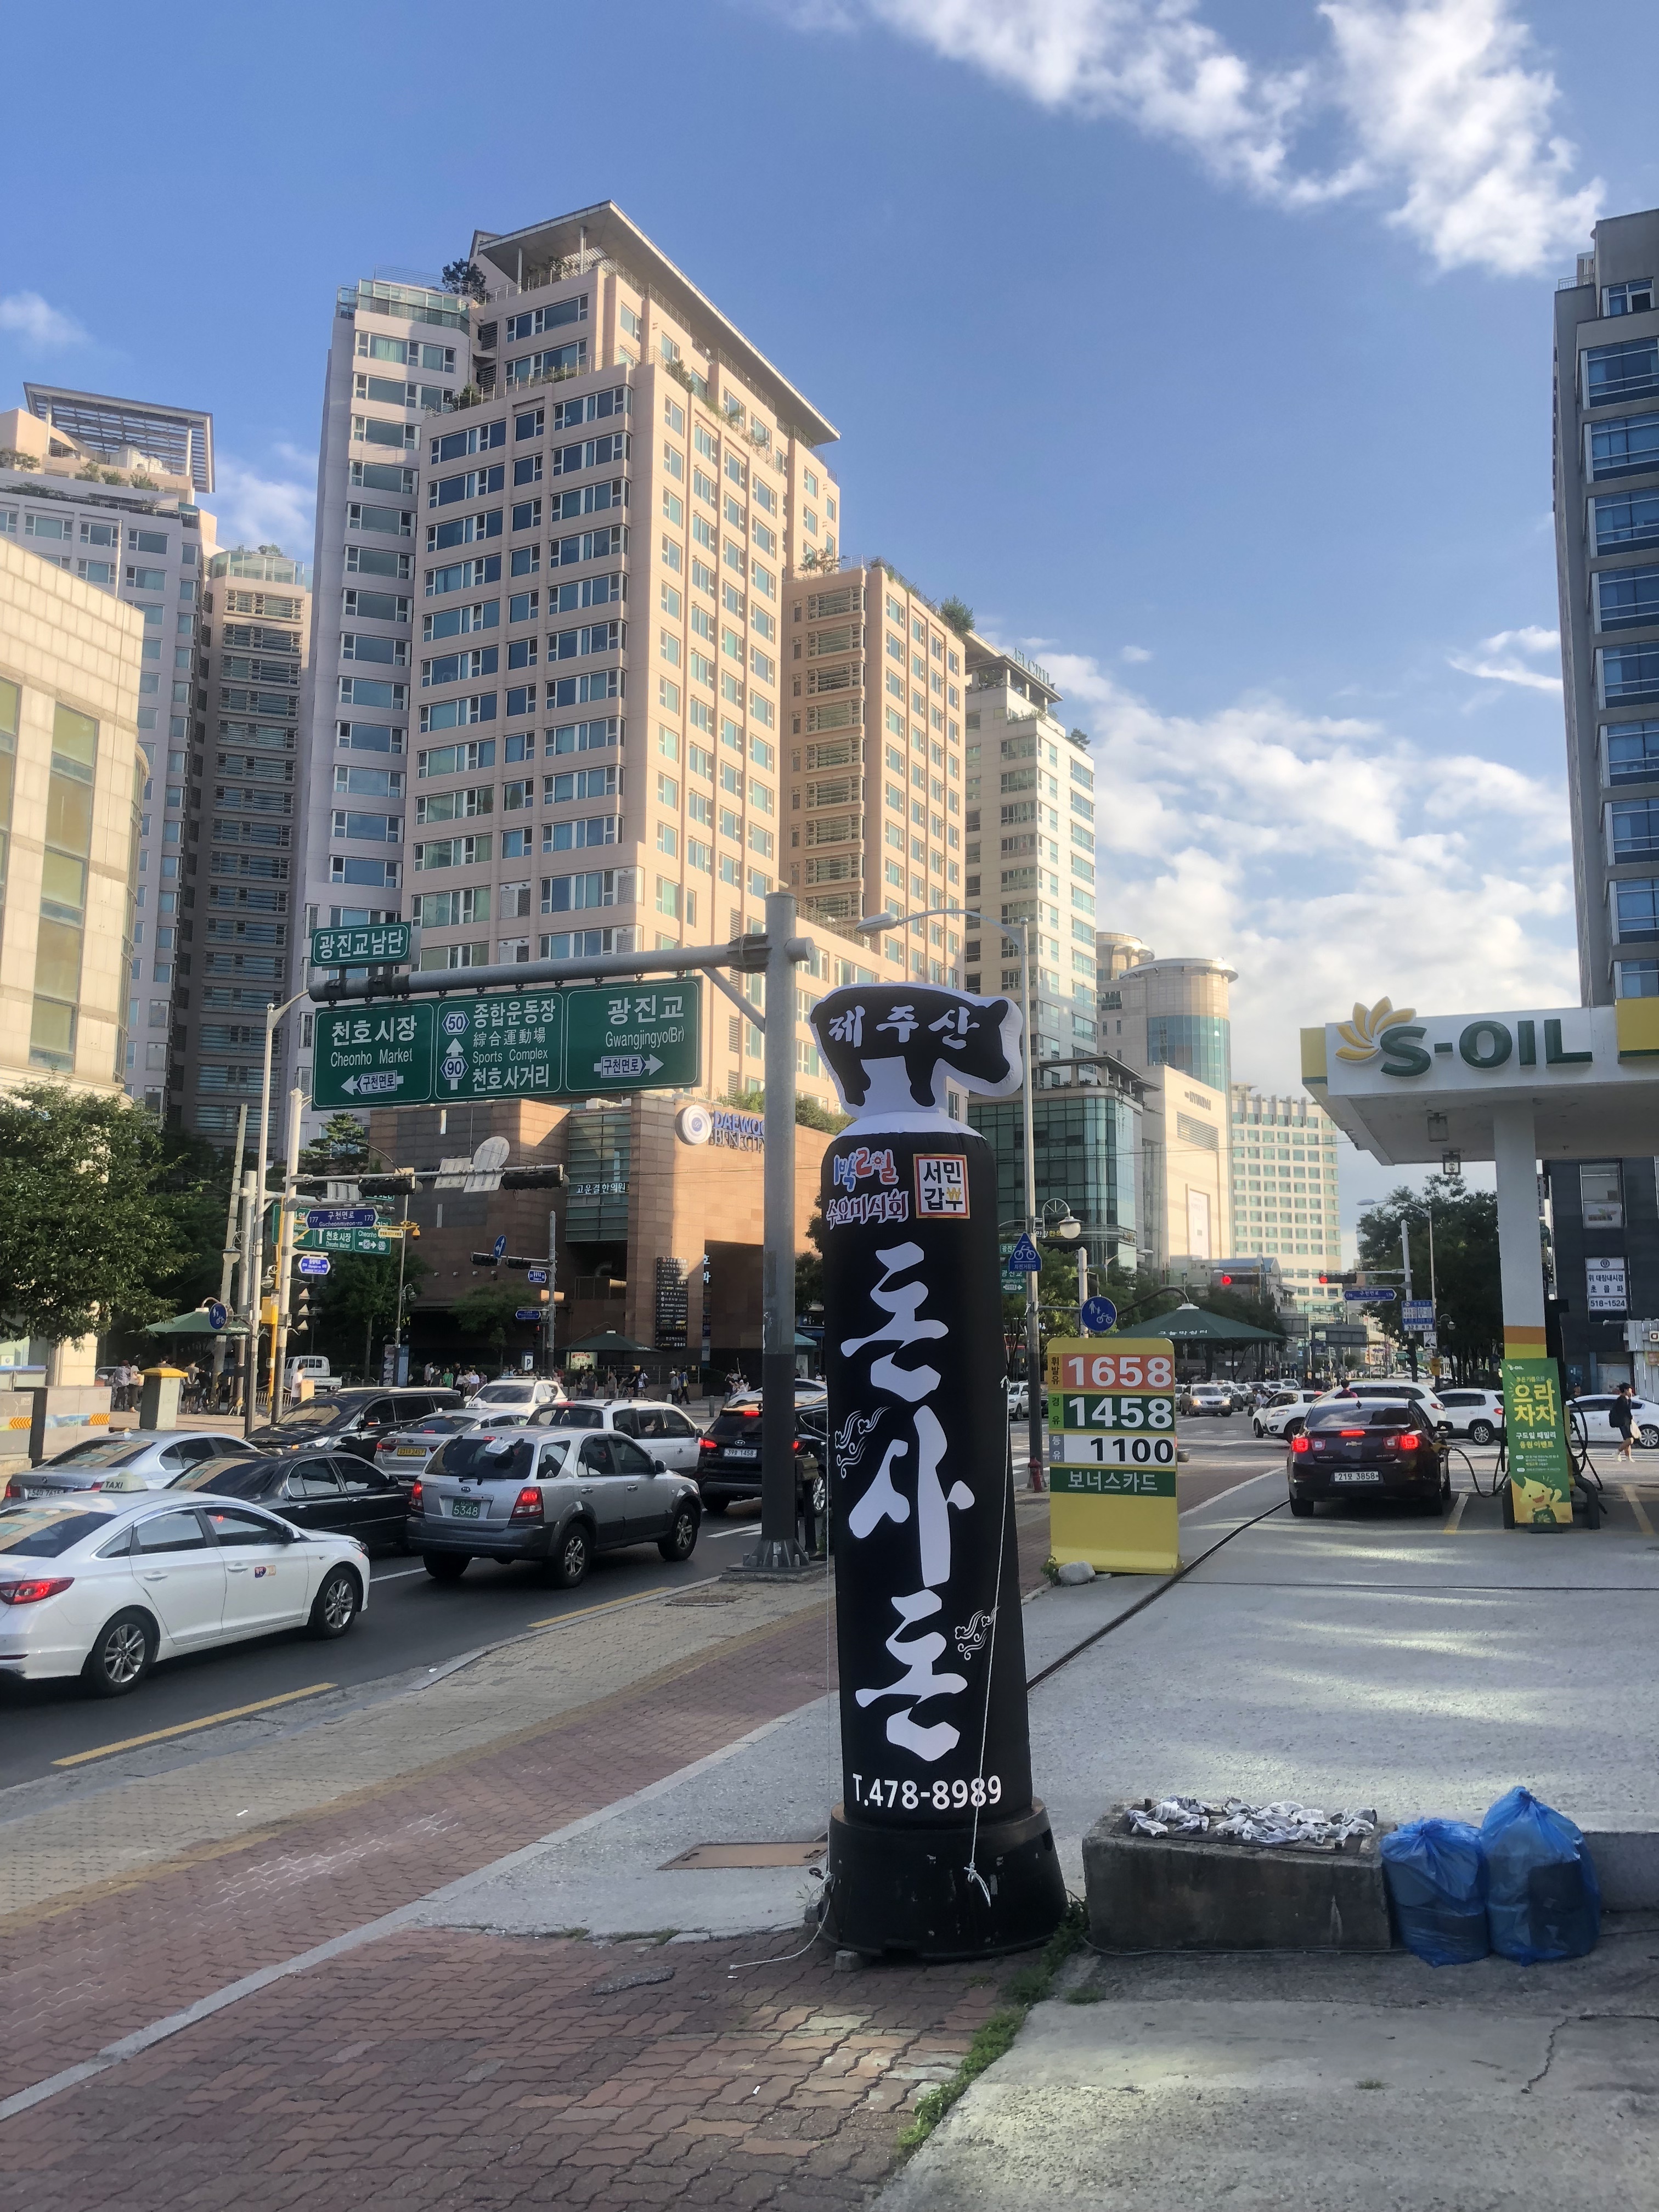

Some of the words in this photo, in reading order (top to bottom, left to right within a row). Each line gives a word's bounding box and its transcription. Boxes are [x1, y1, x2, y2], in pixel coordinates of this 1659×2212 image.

[319, 929, 403, 959] 광진교남단
[473, 998, 556, 1028] 종합운동장
[607, 995, 685, 1025] 광진교
[448, 1015, 464, 1031] 50
[473, 1026, 546, 1048] 綜合運動場
[605, 1025, 685, 1050] Gwangjingyo(Br)
[1380, 1019, 1593, 1077] S-OIL
[330, 1049, 373, 1068] Cheonho
[379, 1047, 413, 1064] Market
[447, 1060, 462, 1075] 90
[472, 1051, 503, 1066] Sports
[509, 1047, 549, 1062] Complex
[603, 1058, 640, 1075] 구천면로
[363, 1074, 395, 1091] 구천면로
[472, 1063, 550, 1092] 천호사거리
[923, 1160, 961, 1184] 서민
[576, 1182, 625, 1194] 고운결한의원
[328, 1211, 354, 1220] 구천면로
[827, 1188, 909, 1230] 수요미식회
[326, 1231, 351, 1243] 천호시장
[527, 1359, 531, 1368] P
[1051, 1357, 1059, 1385] 휘발유
[1068, 1356, 1172, 1387] 1658
[1513, 1378, 1555, 1402] 으라
[1052, 1397, 1060, 1425] 경유
[1068, 1396, 1172, 1429] 1458
[1514, 1403, 1557, 1426] 차차
[1052, 1436, 1061, 1460] 등유
[1090, 1437, 1174, 1463] 1100
[1068, 1471, 1158, 1492] 보너스카드
[453, 1505, 478, 1516] 5348
[853, 1773, 1002, 1810] T.478-8989
